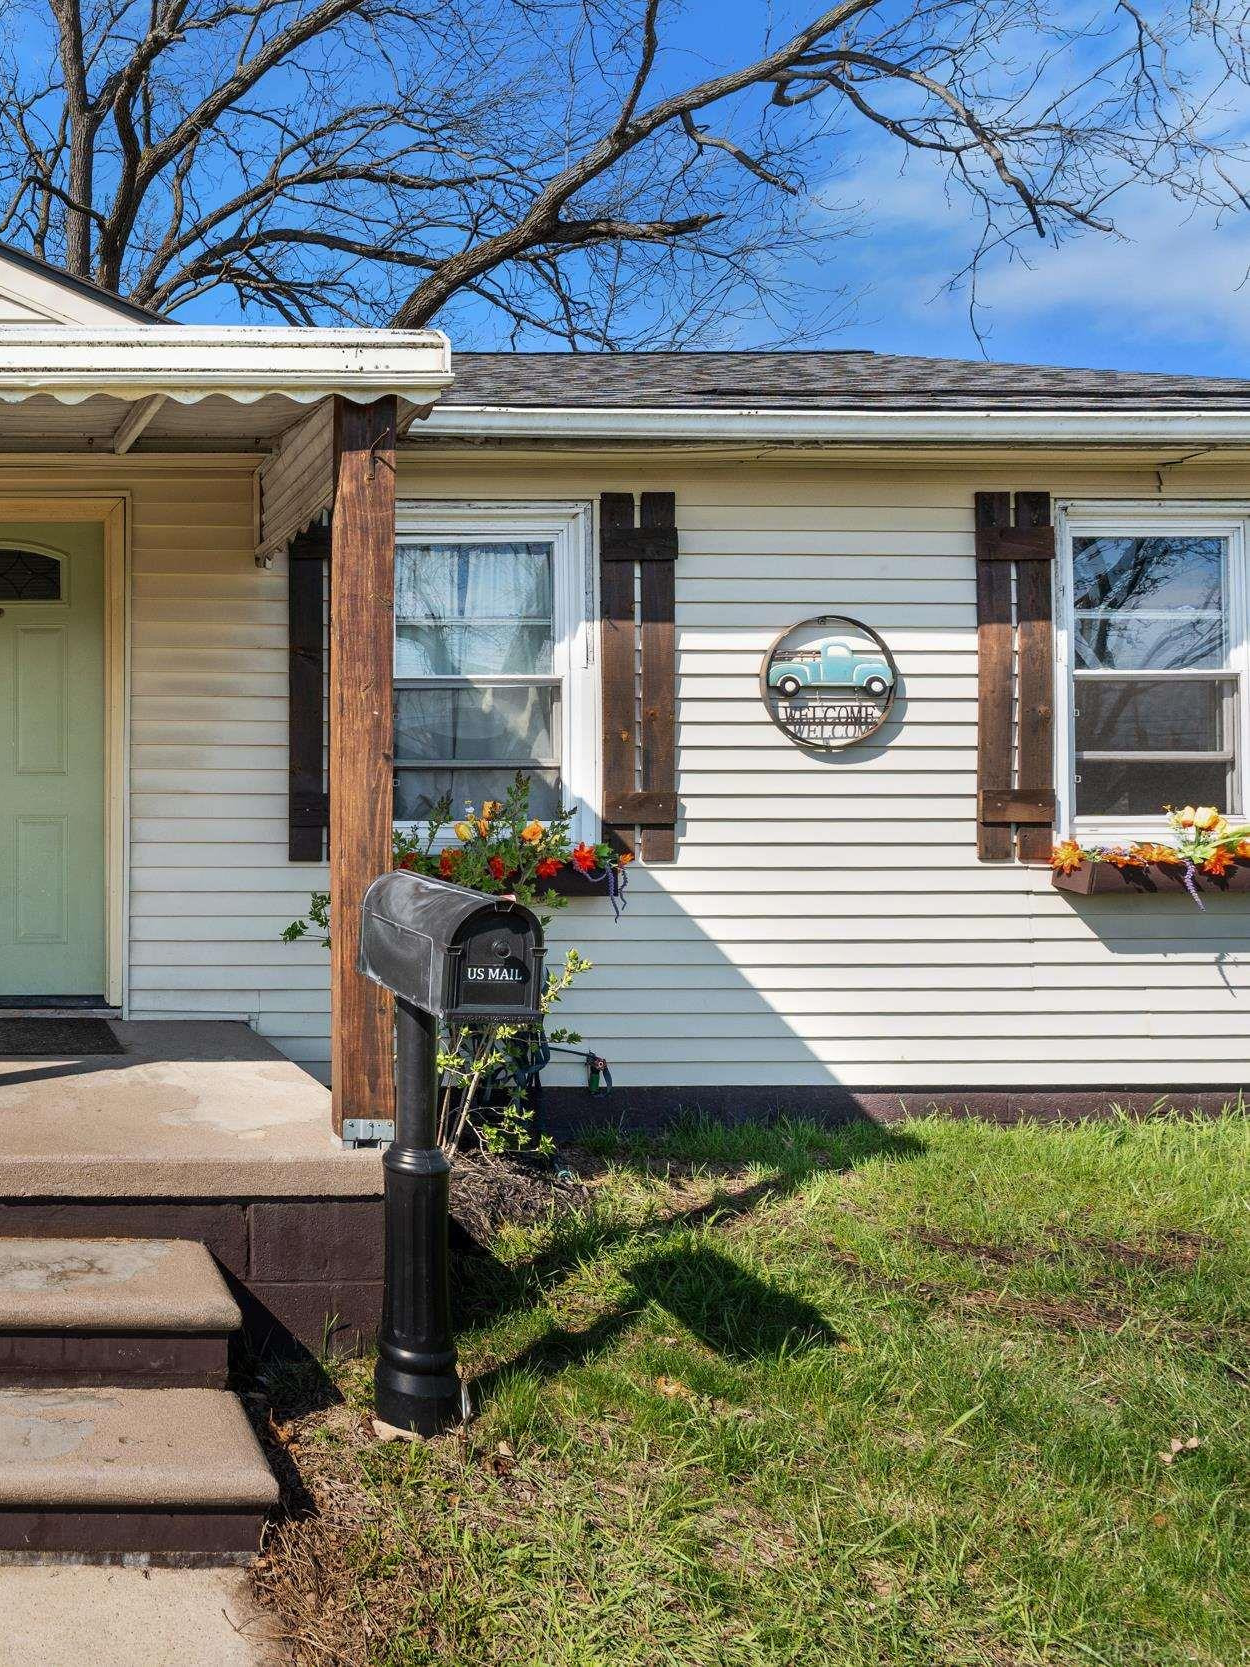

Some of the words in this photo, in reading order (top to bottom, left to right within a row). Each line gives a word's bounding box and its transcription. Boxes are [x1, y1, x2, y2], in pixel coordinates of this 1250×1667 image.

[782, 705, 878, 723] WELCOME
[467, 967, 485, 980] US
[488, 968, 522, 980] MAIL
